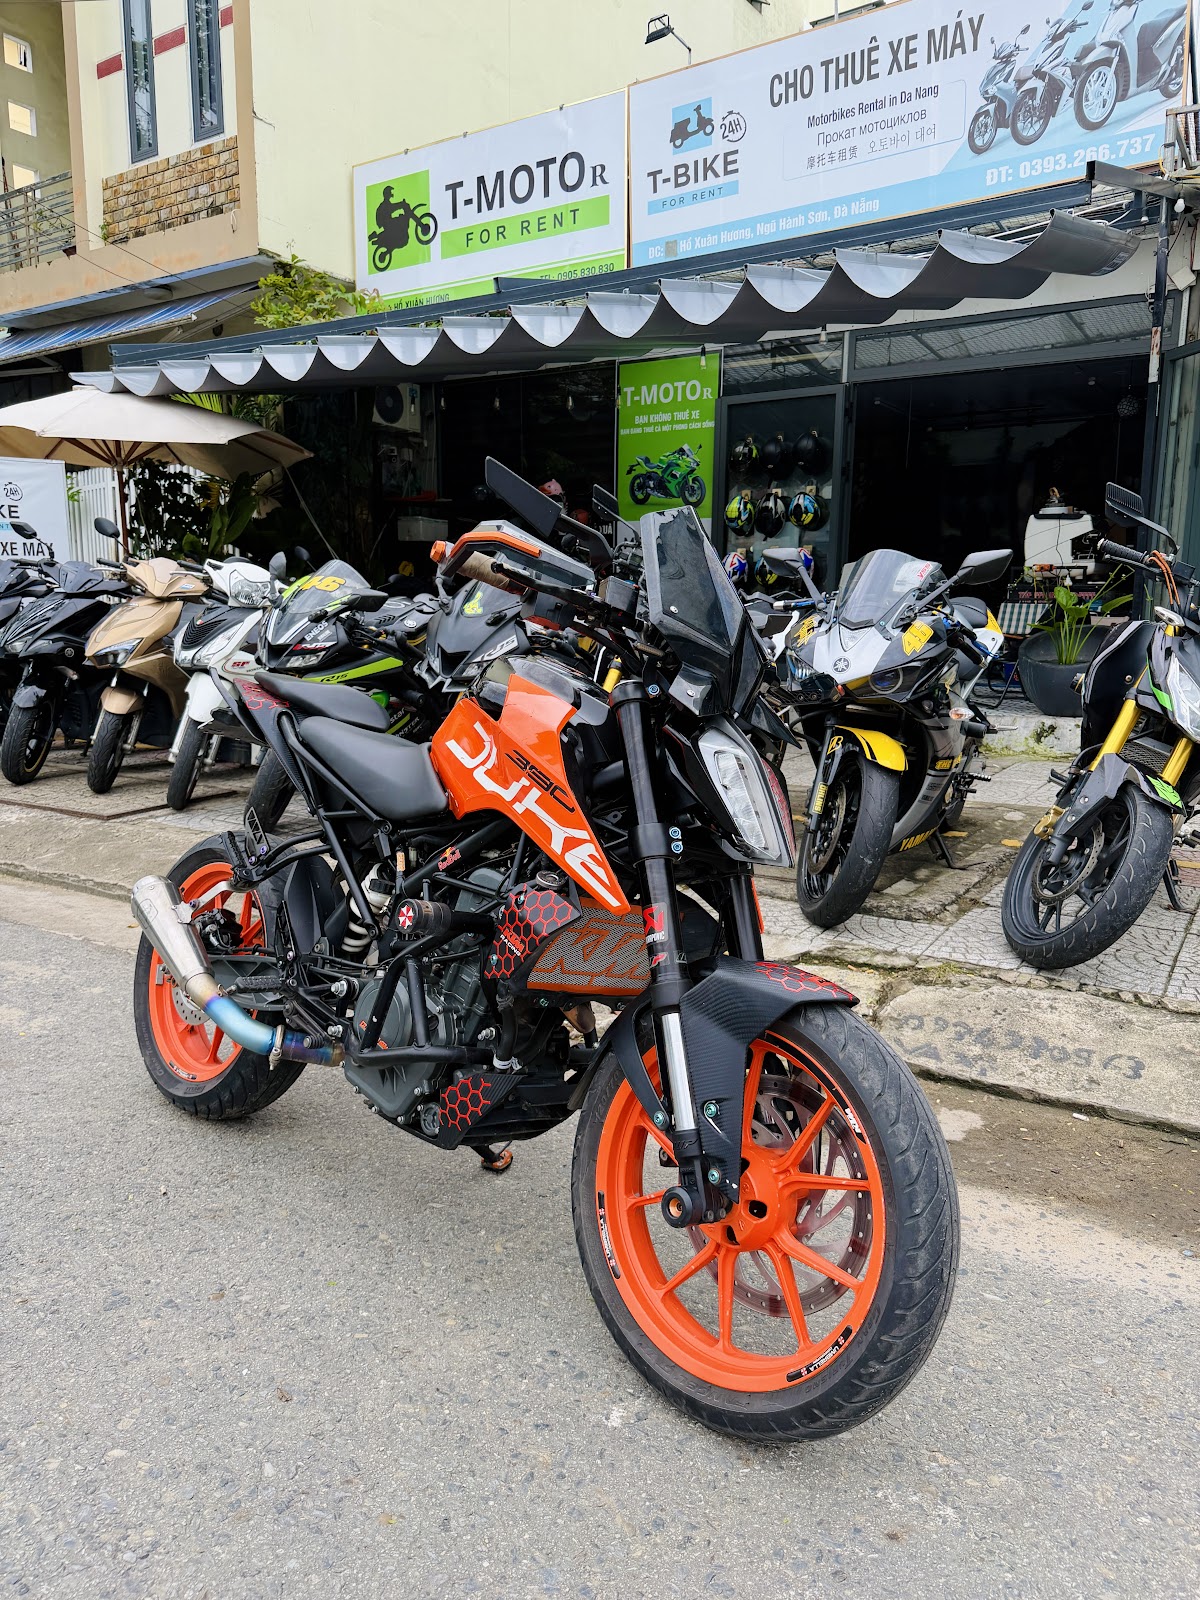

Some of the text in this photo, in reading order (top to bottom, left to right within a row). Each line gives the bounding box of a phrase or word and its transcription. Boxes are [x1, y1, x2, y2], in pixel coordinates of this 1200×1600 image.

[769, 9, 985, 108] CHO THUÊ XE MÁY
[807, 84, 939, 128] Motorbikes Rental in Da Nang
[719, 117, 742, 140] 24H
[817, 108, 927, 147] Прокат мотоциклов
[867, 123, 936, 154] 오토바이 대여
[806, 145, 858, 169] 摩托车租赁
[1019, 133, 1156, 179] 0393.266.737
[647, 149, 739, 194] T-BIKE
[662, 186, 724, 208] FOR RENT
[465, 208, 580, 248] FOR RENT
[694, 233, 718, 249] Xuân
[779, 212, 805, 231] Hành
[557, 262, 615, 280] 0905.830.830
[691, 410, 700, 419] XE
[3, 487, 20, 498] 24H
[0, 542, 19, 556] XE
[304, 620, 329, 642] ENEOS
[902, 620, 934, 656] 46
[499, 934, 522, 957] RACING
[810, 1345, 840, 1372] UMBRELLA
